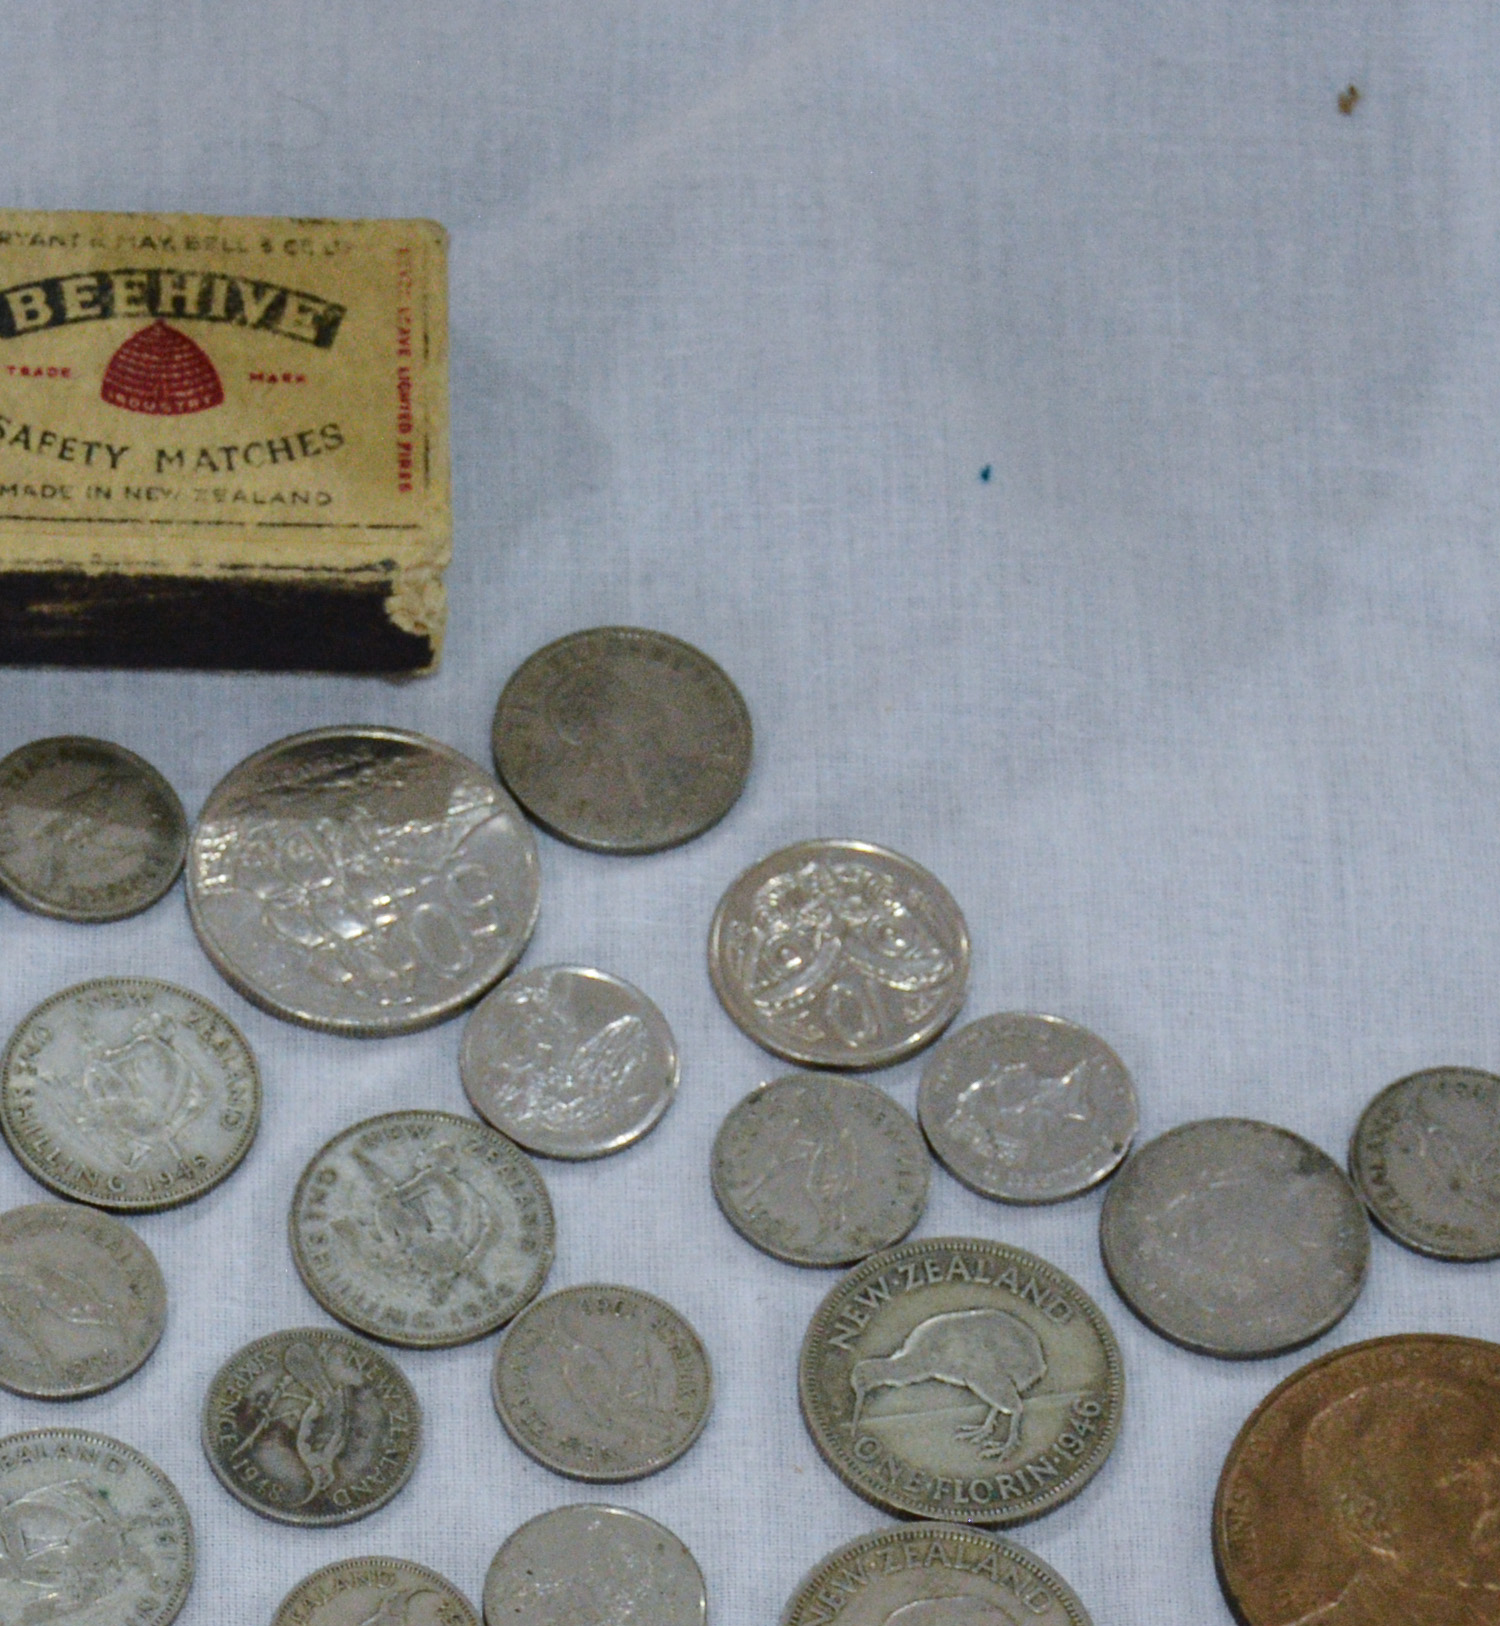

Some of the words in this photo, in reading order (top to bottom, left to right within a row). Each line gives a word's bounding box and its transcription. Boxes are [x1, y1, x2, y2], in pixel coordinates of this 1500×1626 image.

[2, 270, 330, 341] BEEHIVE
[5, 364, 73, 379] TRADE
[248, 370, 308, 386] MARK
[396, 366, 413, 434] LIGHTED
[154, 422, 346, 474] MATCHES
[86, 484, 113, 502] IN
[123, 485, 180, 502] NEW
[192, 487, 334, 507] ZEALAND
[832, 1279, 894, 1353] NEW
[902, 1255, 1076, 1328] ZEALAND
[853, 1433, 926, 1492] ONE
[934, 1459, 1056, 1506] FLORIN
[1057, 1398, 1103, 1463] 1946
[878, 1541, 1051, 1616] ZEALAND
